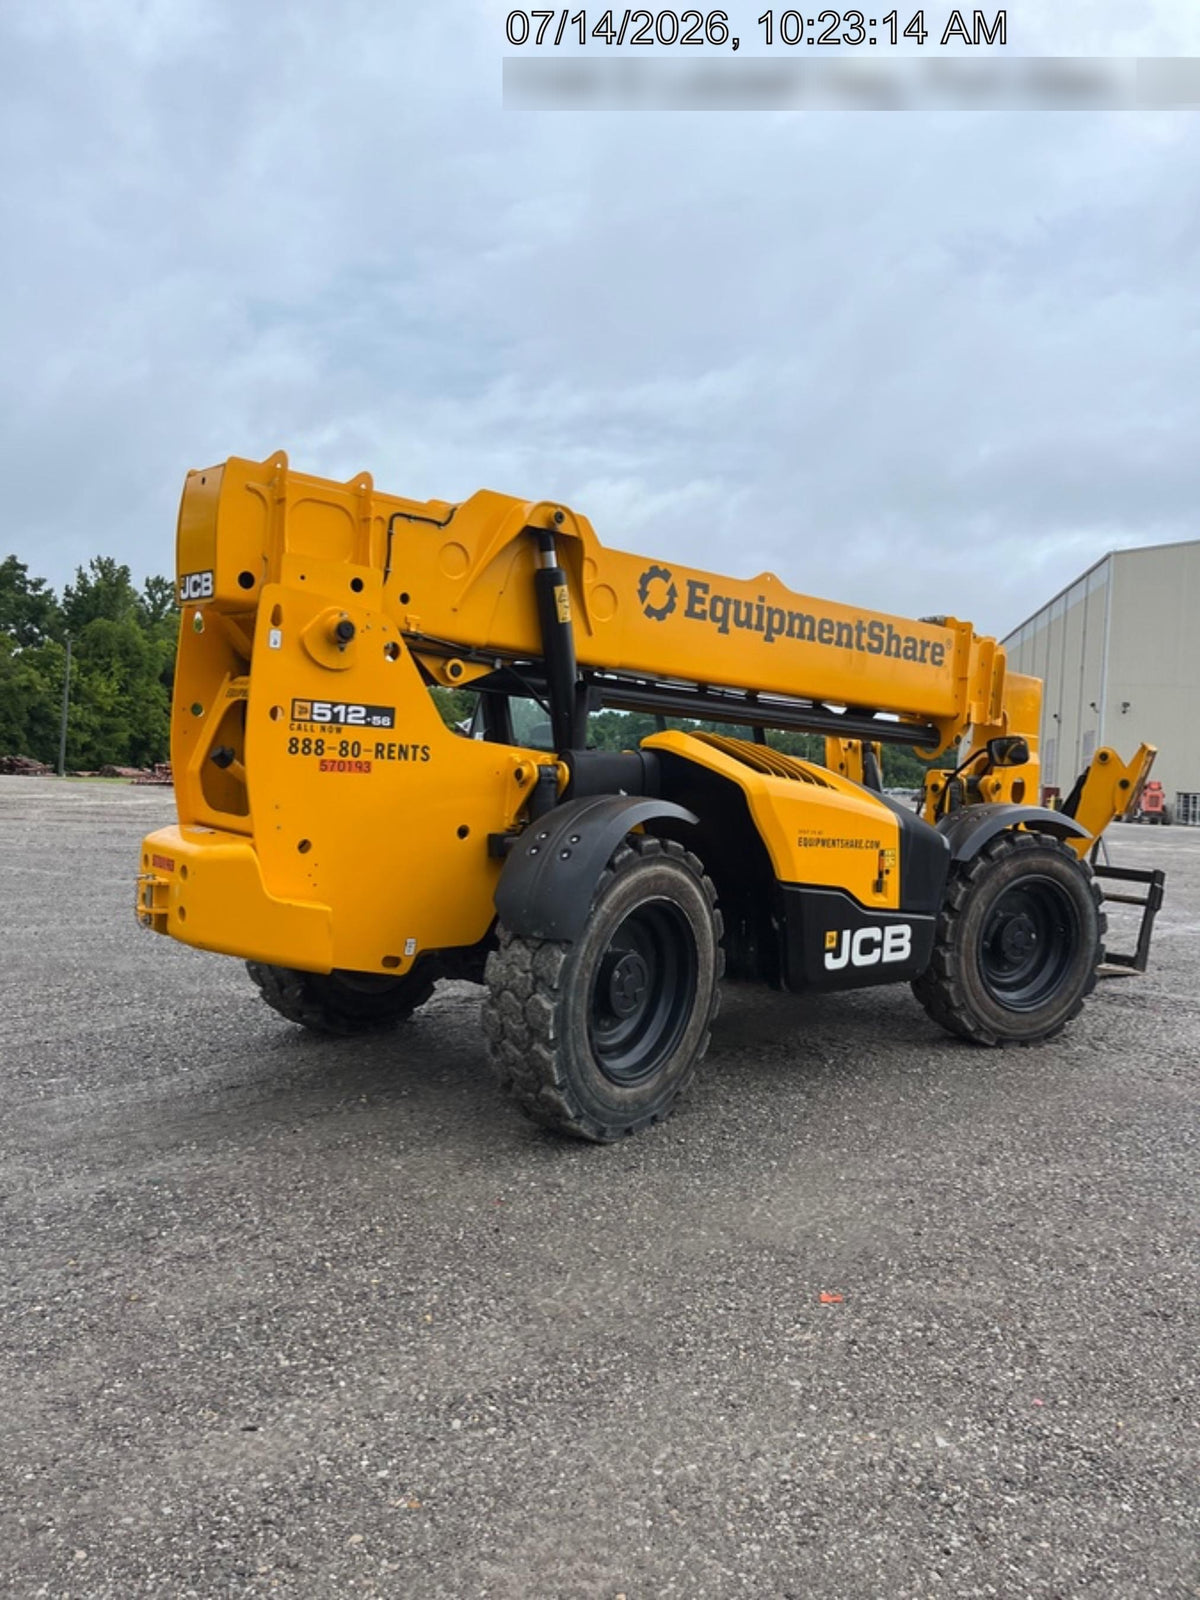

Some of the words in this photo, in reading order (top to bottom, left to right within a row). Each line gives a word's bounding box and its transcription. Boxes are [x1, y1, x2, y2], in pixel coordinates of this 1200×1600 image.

[180, 571, 213, 600] JCB
[684, 578, 946, 668] EquipmentShare
[289, 723, 316, 733] CALL
[320, 725, 343, 734] NOW
[288, 736, 431, 762] 888-80-RENTS
[319, 759, 372, 774] 570193
[797, 836, 881, 850] EQUIPMENTSHARE.COM
[824, 923, 913, 971] JCB
